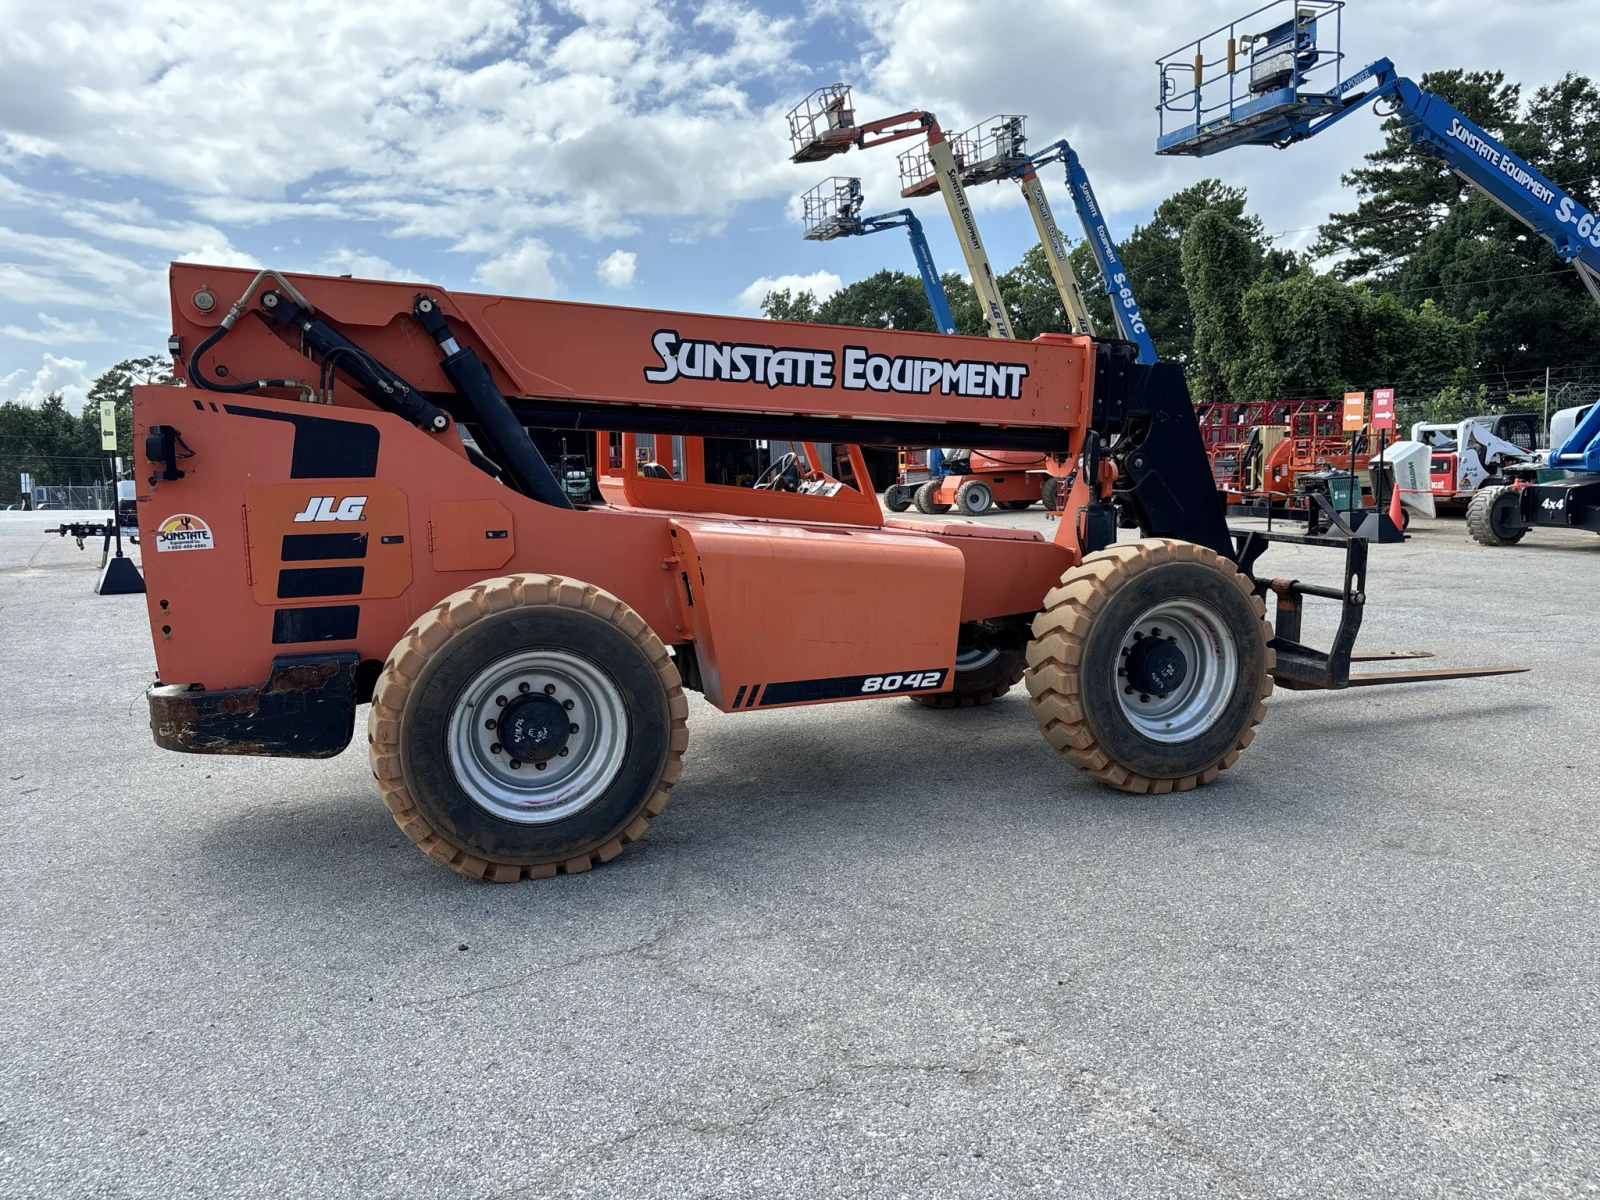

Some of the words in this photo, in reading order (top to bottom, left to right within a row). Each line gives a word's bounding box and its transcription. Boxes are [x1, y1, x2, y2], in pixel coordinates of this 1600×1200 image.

[1346, 70, 1371, 89] POWER
[1445, 117, 1501, 166] SUNSTATE
[1498, 153, 1556, 206] EQUIPMENT
[946, 168, 966, 207] SUNSTATE
[961, 207, 981, 251] EQUIPMENT
[1033, 186, 1050, 222] SUNSTATE
[1046, 223, 1066, 262] EQUIPMENT
[1079, 181, 1098, 218] SUNSTATE
[1096, 224, 1117, 264] EQUIPMENT
[1113, 272, 1136, 309] S-65
[1128, 311, 1146, 334] XC
[988, 300, 1002, 319] JLG
[1077, 316, 1090, 334] JLG
[645, 330, 835, 388] SUNSTATE
[843, 347, 1028, 398] EQUIPMENT
[293, 495, 369, 523] JLG
[1541, 498, 1564, 510] 4x4
[158, 530, 211, 542] SUNSTATE
[861, 672, 941, 693] 8042
